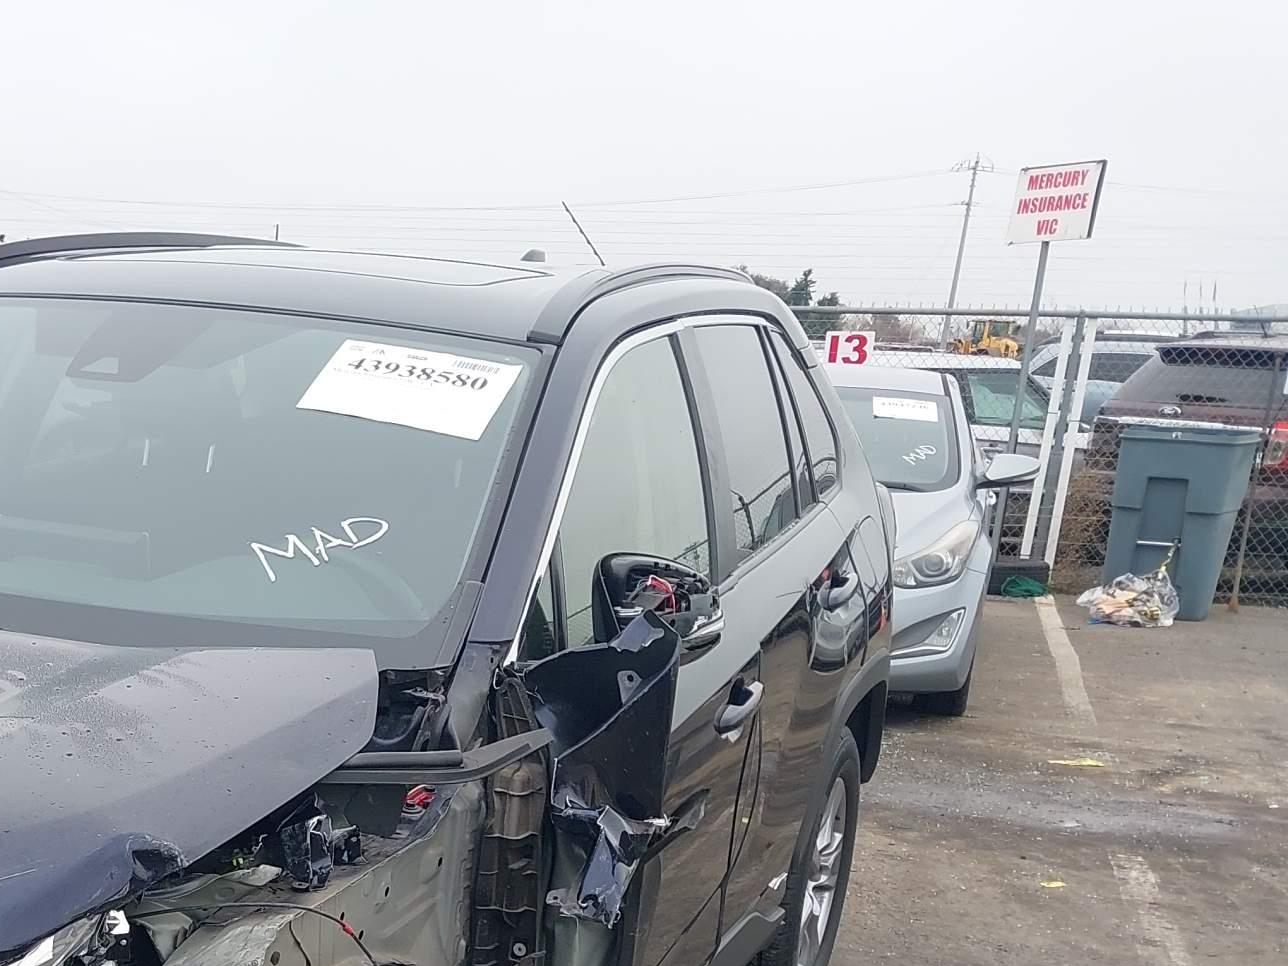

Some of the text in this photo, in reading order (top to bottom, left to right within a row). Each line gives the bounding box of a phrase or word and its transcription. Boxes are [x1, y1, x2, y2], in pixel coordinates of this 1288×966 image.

[1027, 170, 1090, 191] MERCURY
[1017, 193, 1089, 214] INSURANCE
[1036, 219, 1059, 236] VIC
[828, 334, 868, 364] 13
[348, 357, 489, 390] 43938580
[902, 445, 937, 466] MAD
[248, 516, 390, 583] MAD
